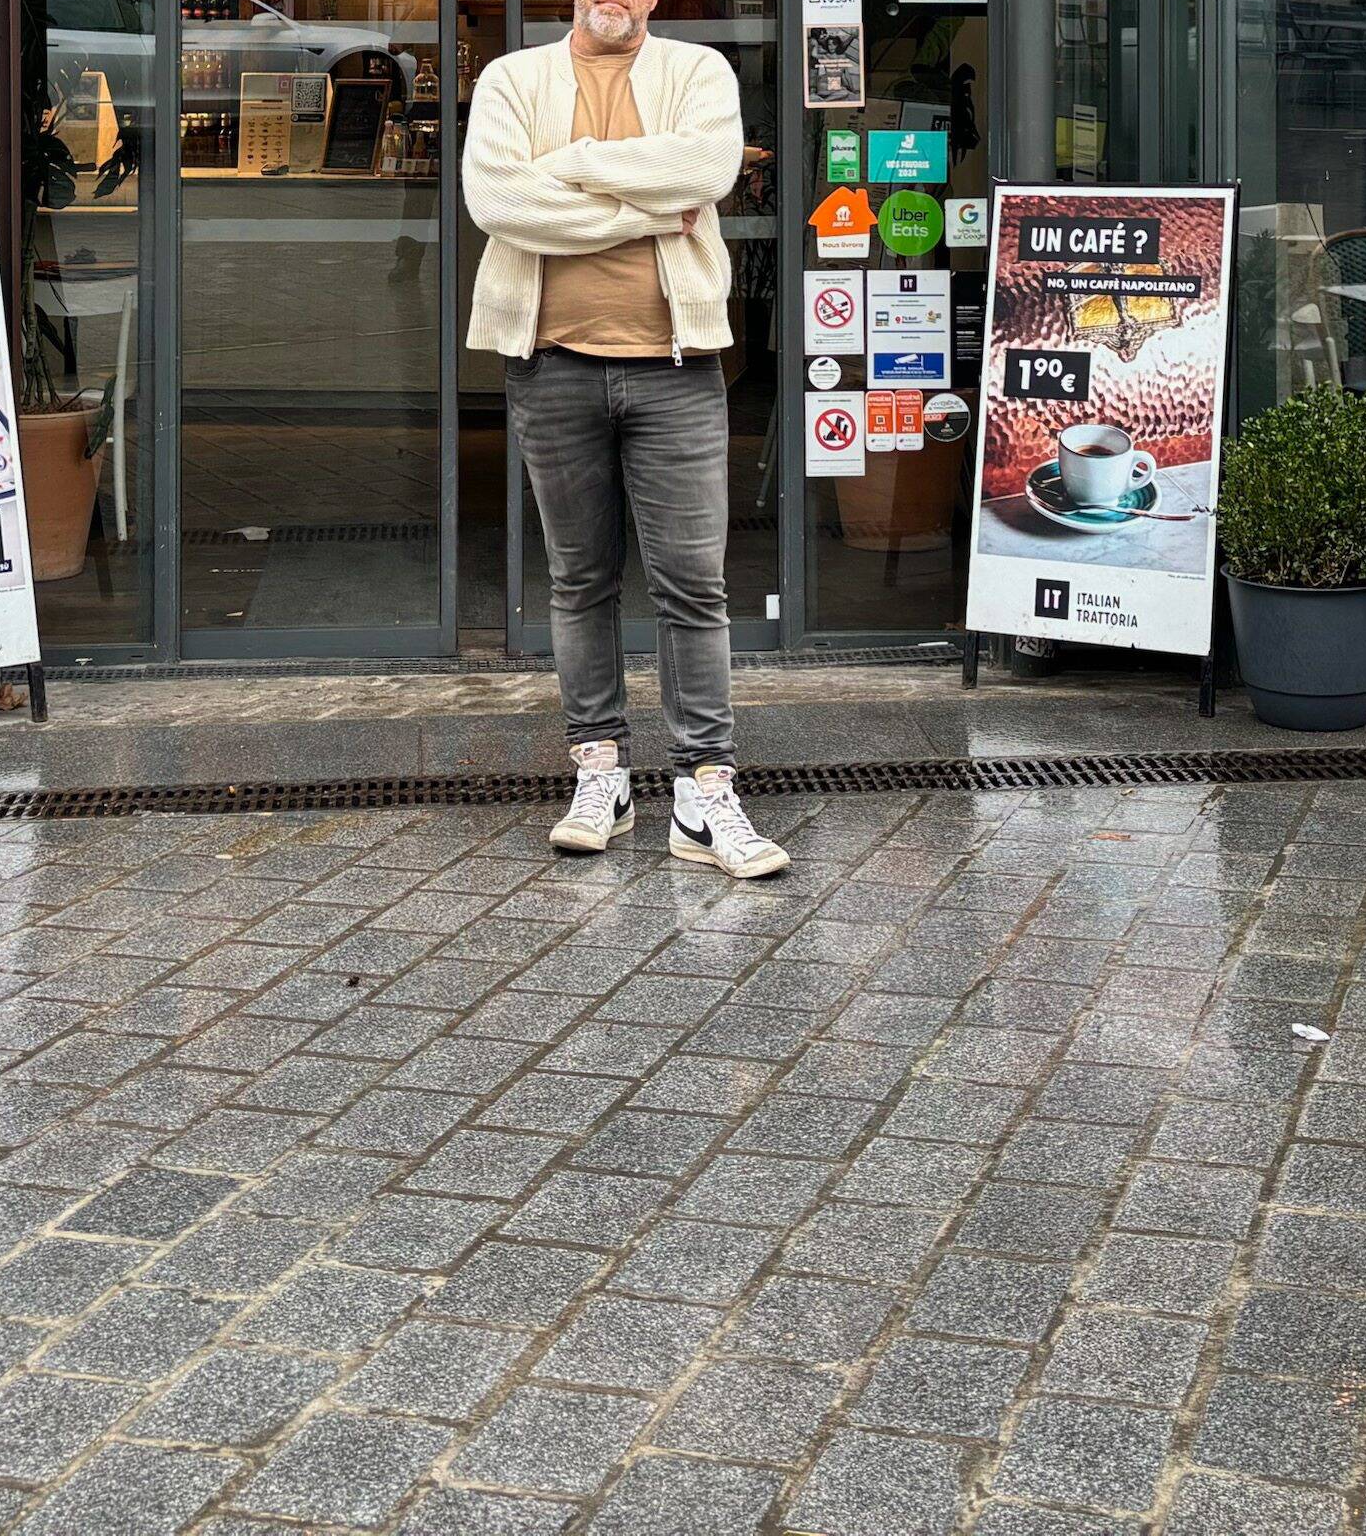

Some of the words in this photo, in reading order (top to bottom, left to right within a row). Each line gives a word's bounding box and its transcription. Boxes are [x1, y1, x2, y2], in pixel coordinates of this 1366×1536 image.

[892, 207, 929, 221] Uber
[891, 223, 929, 237] Eats
[1030, 227, 1063, 253] UN
[1069, 222, 1125, 255] CAFÉ
[1133, 229, 1149, 255] ?
[1046, 278, 1069, 290] NO,
[1071, 279, 1087, 290] UN
[1121, 280, 1196, 293] NAPOLETANO
[1043, 588, 1062, 610] IT
[1077, 592, 1121, 610] ITALIAN
[1076, 608, 1139, 628] TRATTORIA
